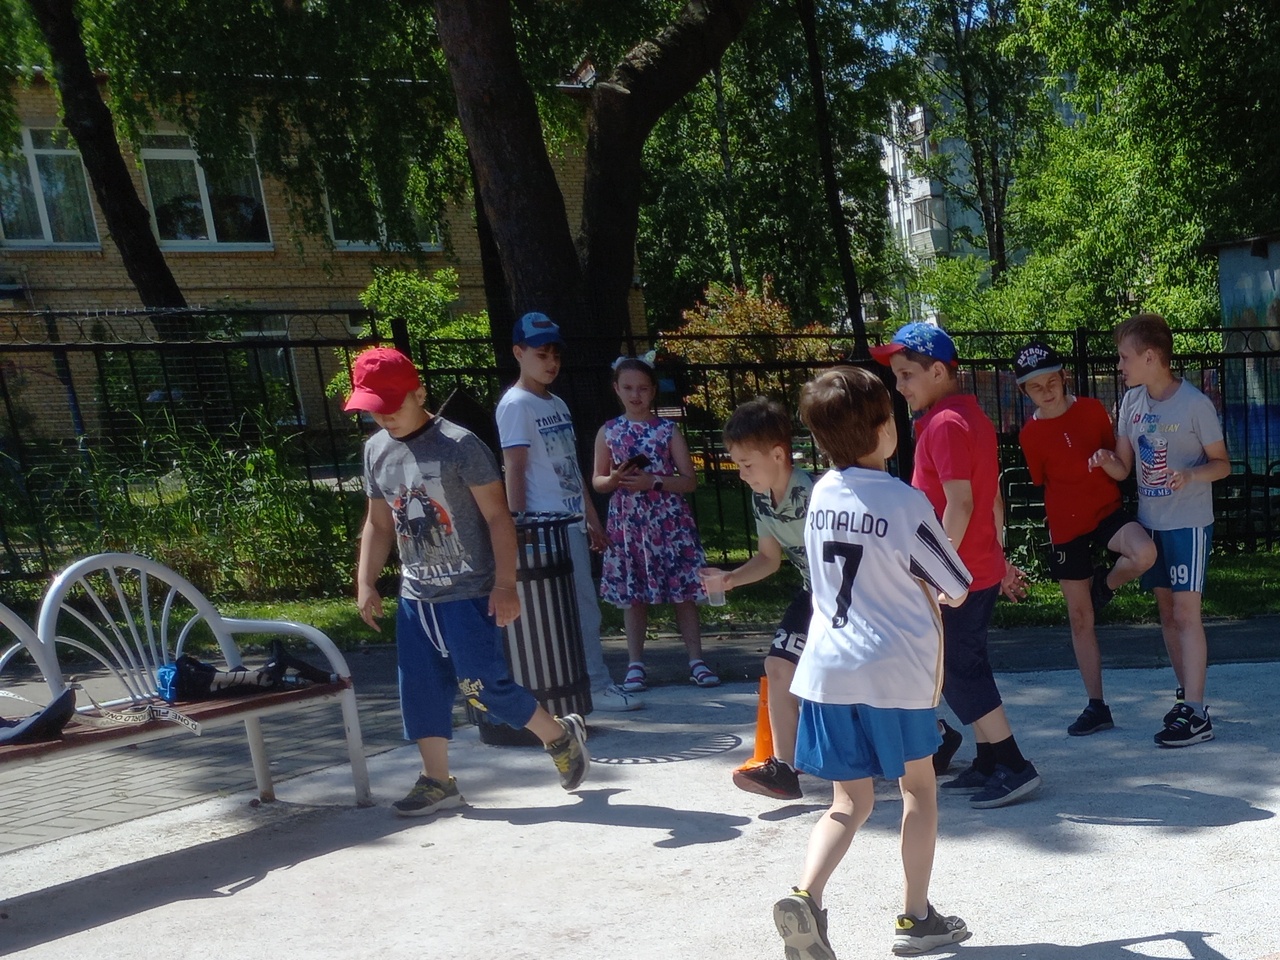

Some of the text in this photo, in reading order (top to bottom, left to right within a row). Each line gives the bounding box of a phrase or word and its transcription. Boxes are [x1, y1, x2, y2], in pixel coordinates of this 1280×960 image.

[1017, 347, 1049, 366] DETROIT
[809, 509, 889, 538] RONALDO
[822, 540, 864, 629] 7
[1169, 564, 1189, 586] 99
[172, 713, 190, 726] ONE
